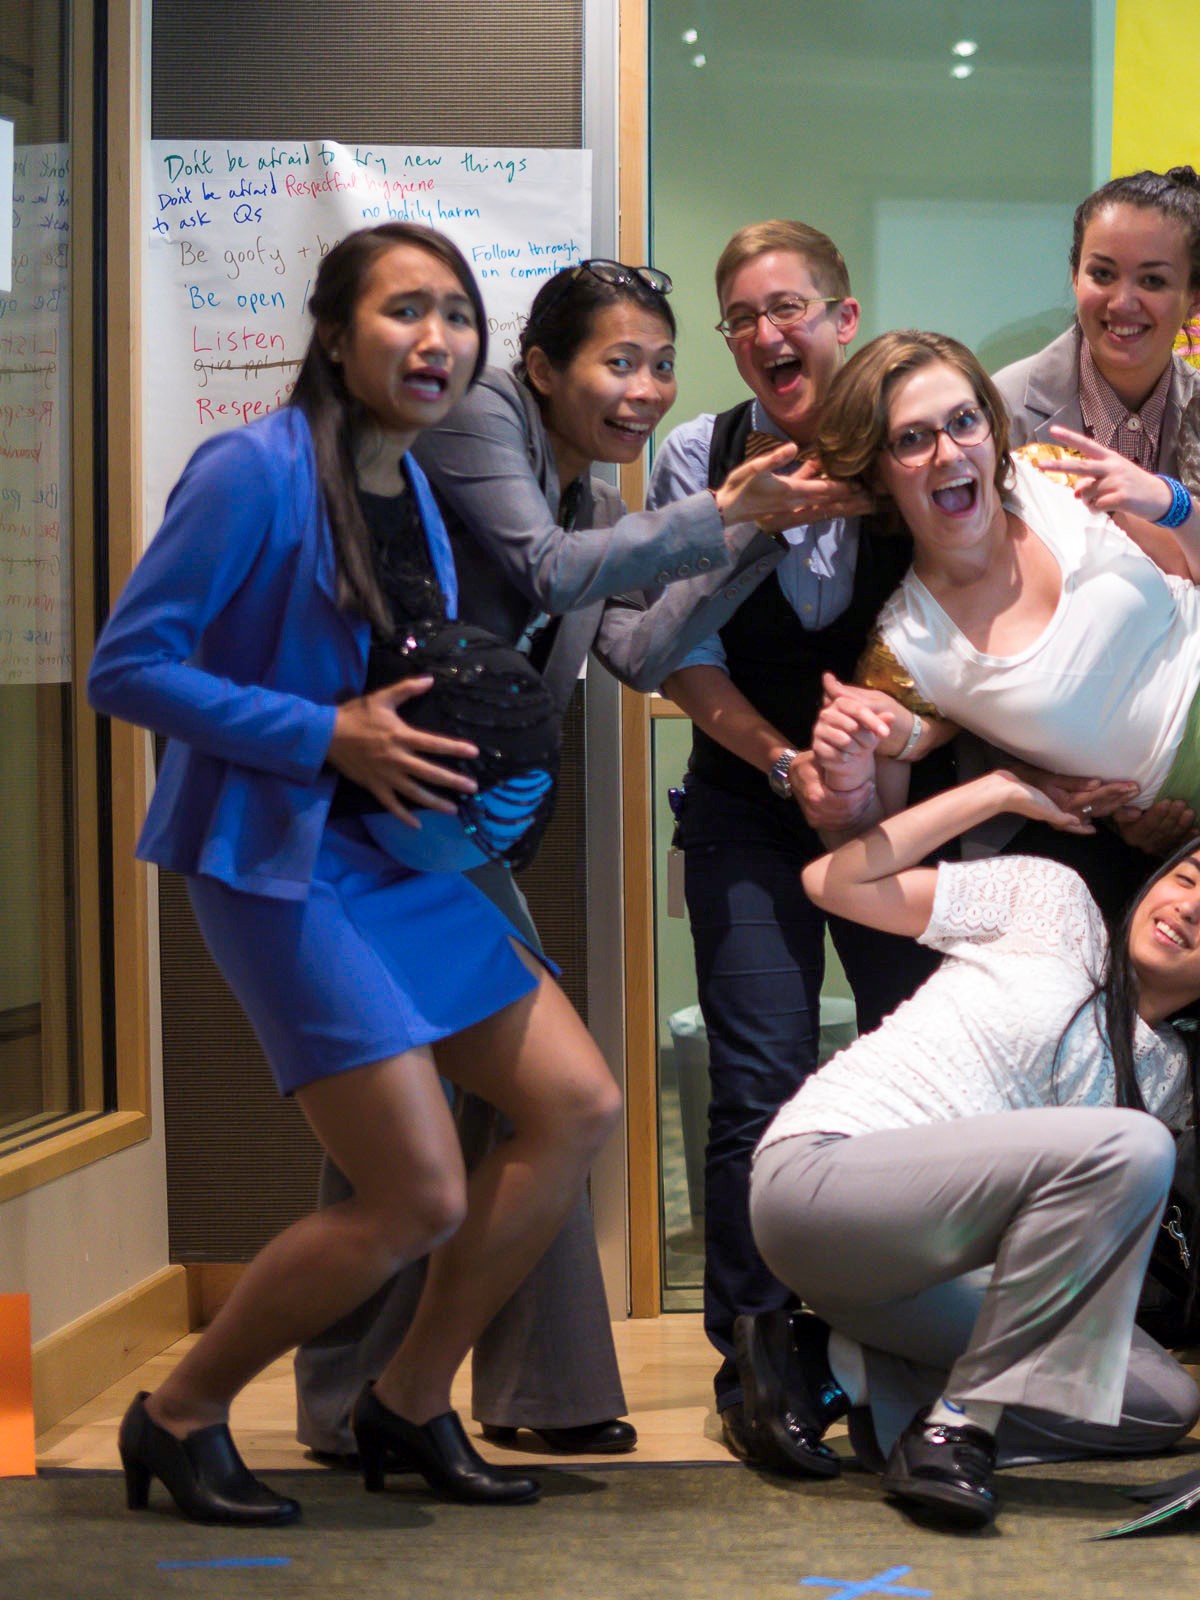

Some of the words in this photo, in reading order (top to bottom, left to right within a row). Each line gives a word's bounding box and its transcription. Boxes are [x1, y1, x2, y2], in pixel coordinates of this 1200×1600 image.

[164, 150, 213, 183] Don't
[227, 150, 248, 171] be
[258, 144, 310, 170] afraid
[318, 144, 335, 162] to
[353, 148, 387, 174] try
[404, 155, 442, 167] new
[461, 152, 527, 183] things
[158, 187, 193, 210] Don't
[202, 181, 221, 201] be
[229, 171, 276, 198] afraid
[152, 219, 169, 234] to
[179, 210, 211, 230] ask
[234, 204, 263, 224] Qs
[362, 207, 379, 218] no
[387, 200, 435, 230] bodily
[438, 200, 480, 219] harm
[180, 240, 208, 267] Be
[224, 235, 286, 280] goofy
[472, 243, 521, 262] Follow
[528, 239, 580, 261] through
[482, 268, 499, 278] on
[189, 286, 220, 310] Be
[237, 291, 285, 314] open
[193, 325, 285, 352] Listen
